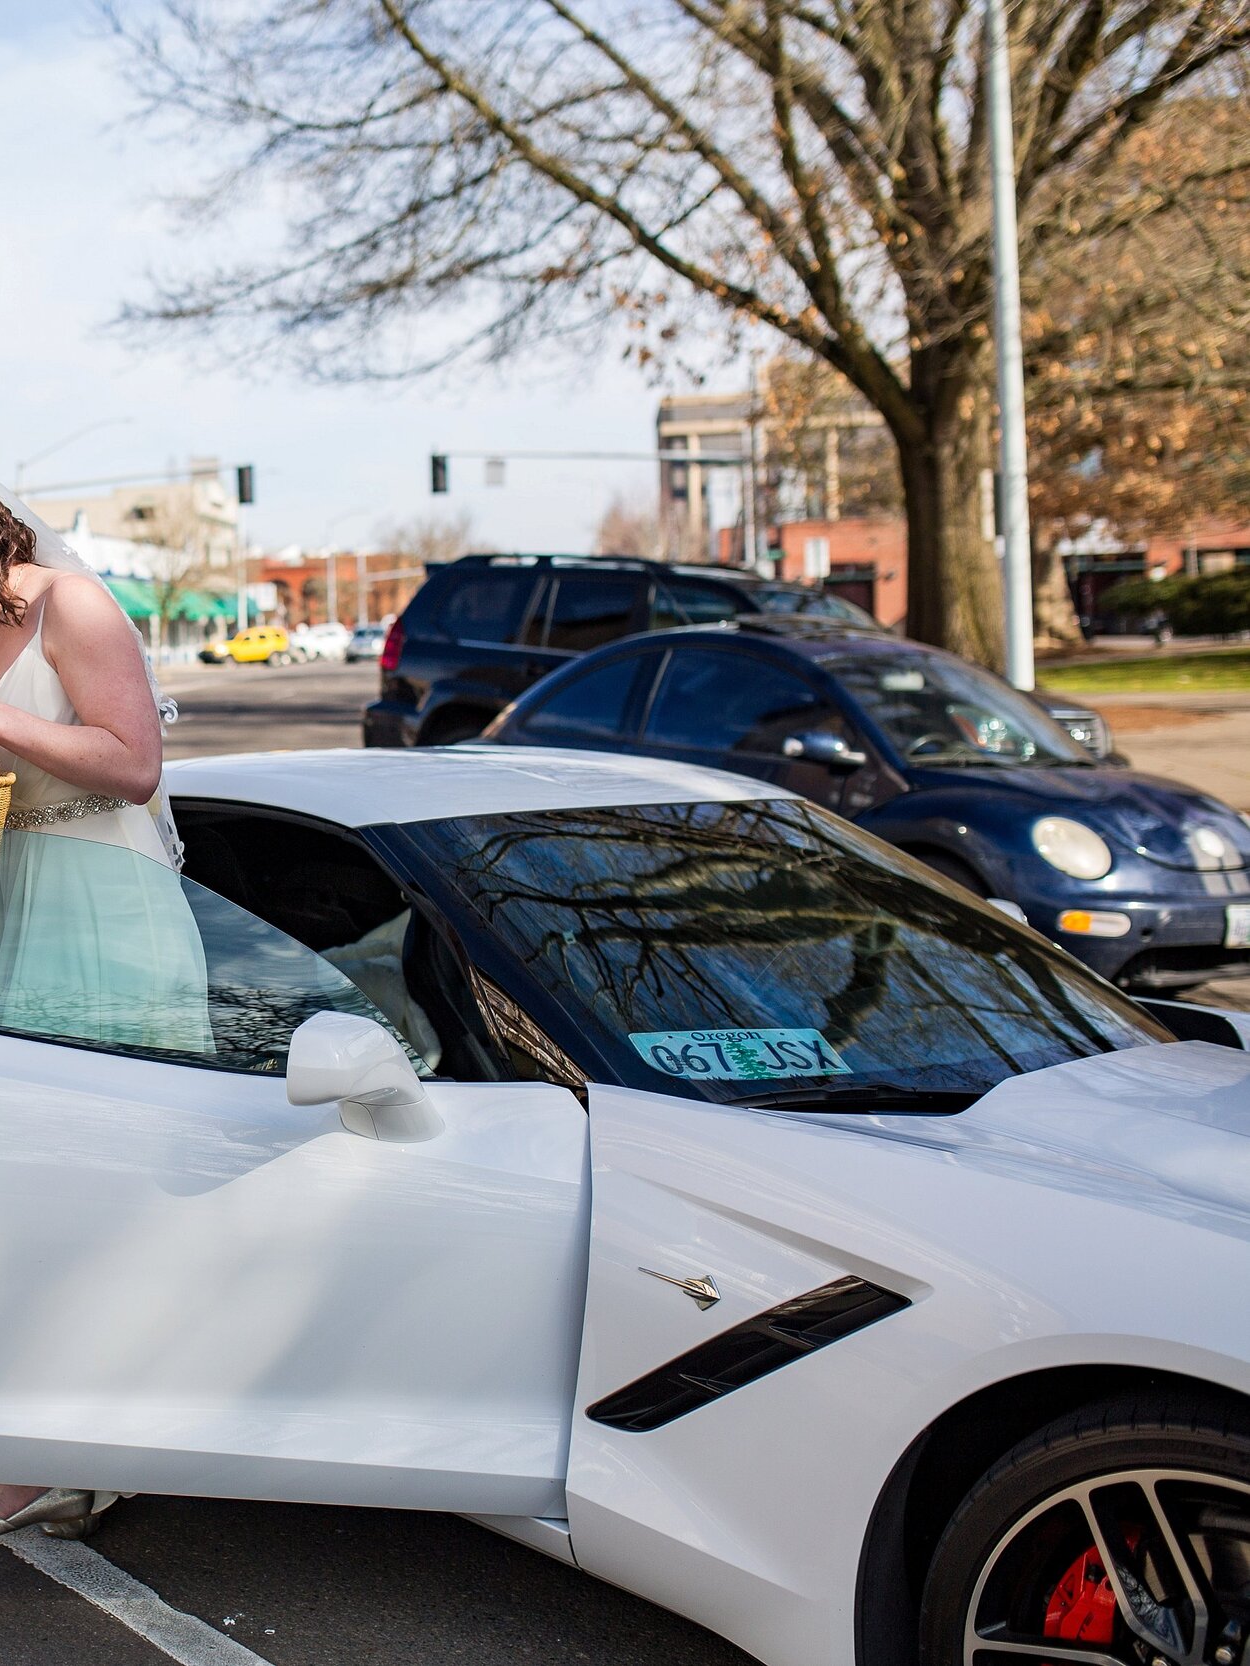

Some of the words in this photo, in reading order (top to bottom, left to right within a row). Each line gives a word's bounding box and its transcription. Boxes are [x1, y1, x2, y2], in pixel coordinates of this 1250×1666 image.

[690, 1030, 763, 1042] Oregon
[650, 1042, 733, 1075] 067
[758, 1039, 842, 1071] JSX
